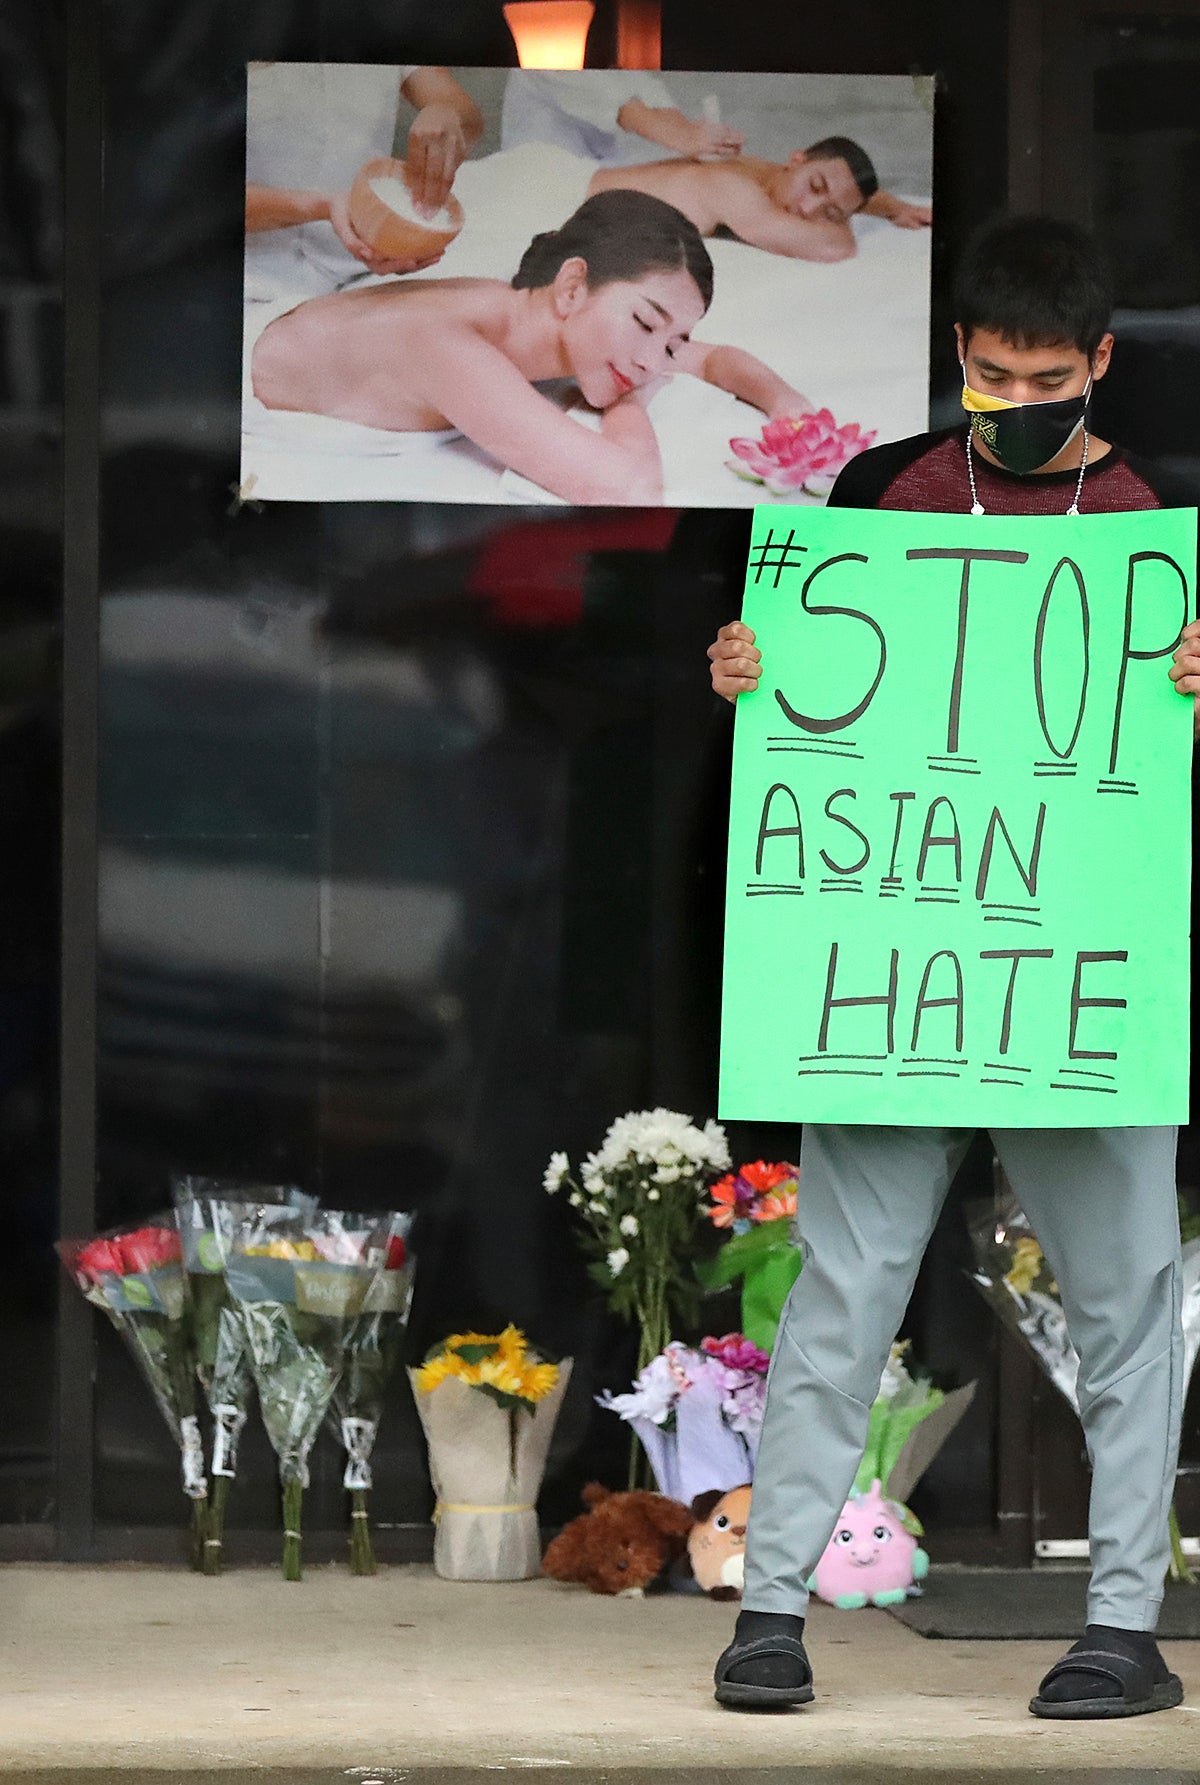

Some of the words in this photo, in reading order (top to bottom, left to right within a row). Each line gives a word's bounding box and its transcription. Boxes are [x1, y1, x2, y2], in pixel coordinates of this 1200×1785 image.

[750, 529, 1188, 774] #STOP
[756, 783, 1046, 900] ASIAN
[818, 942, 1128, 1060] HATE
